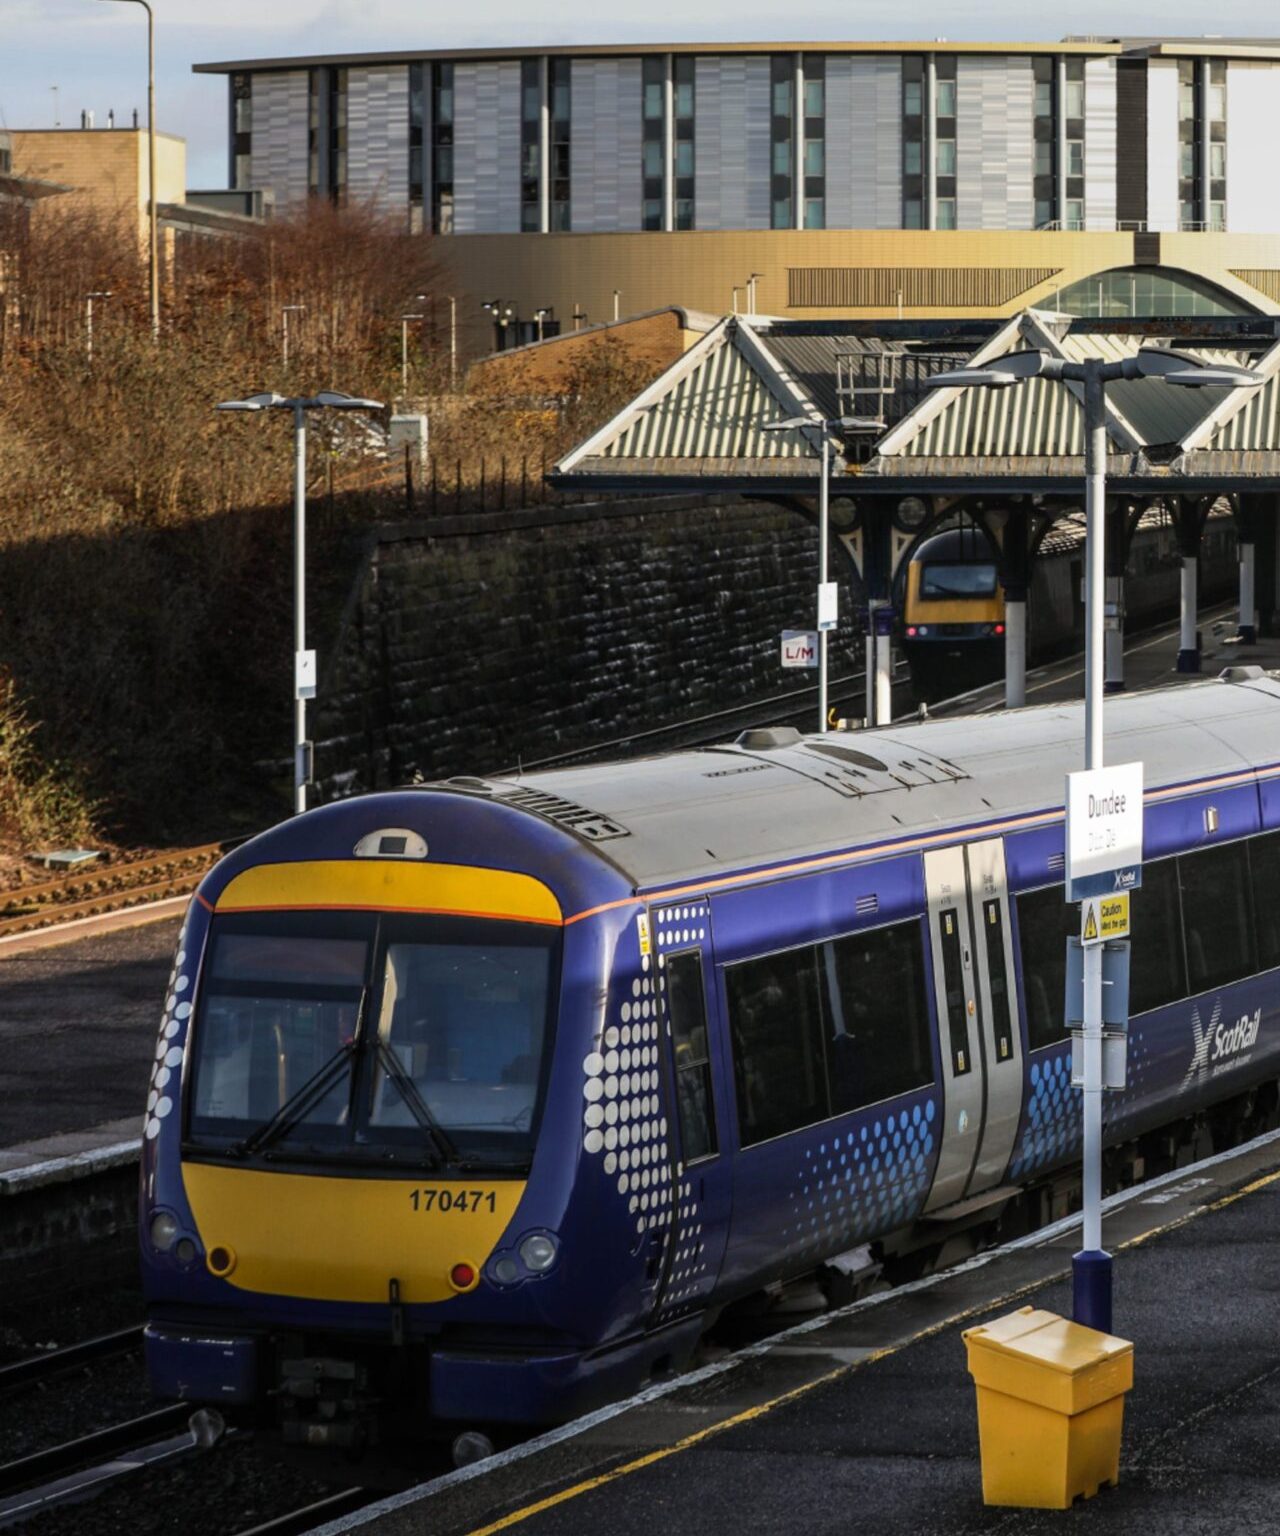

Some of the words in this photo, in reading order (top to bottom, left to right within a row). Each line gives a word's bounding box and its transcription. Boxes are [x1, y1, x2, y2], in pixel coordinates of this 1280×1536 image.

[786, 647, 814, 659] L/M
[1088, 789, 1126, 819] Dundee
[1101, 903, 1122, 918] Caution
[1211, 1008, 1261, 1061] ScotRail
[409, 1189, 496, 1213] 170471
